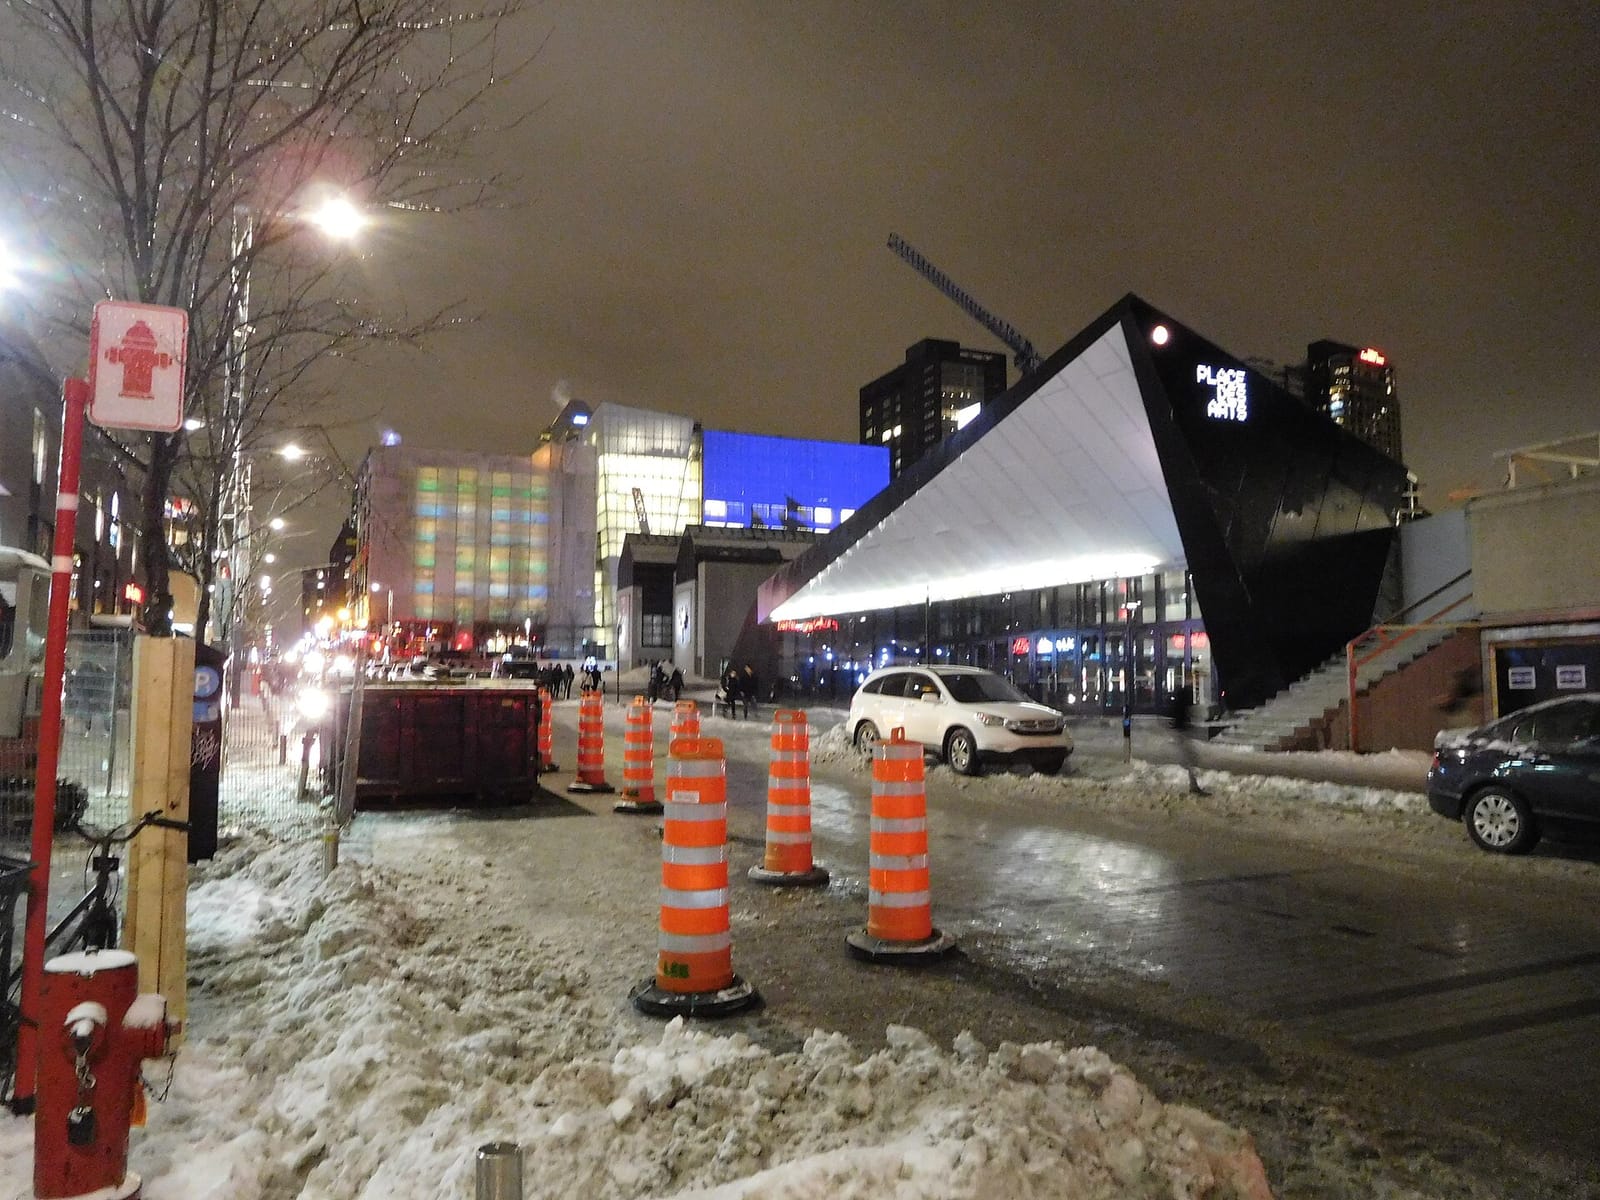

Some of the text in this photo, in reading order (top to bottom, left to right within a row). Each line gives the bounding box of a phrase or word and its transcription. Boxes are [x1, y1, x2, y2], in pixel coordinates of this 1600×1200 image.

[1197, 364, 1246, 386] PLACE
[1217, 383, 1247, 402] DES
[1207, 399, 1247, 421] ARTS
